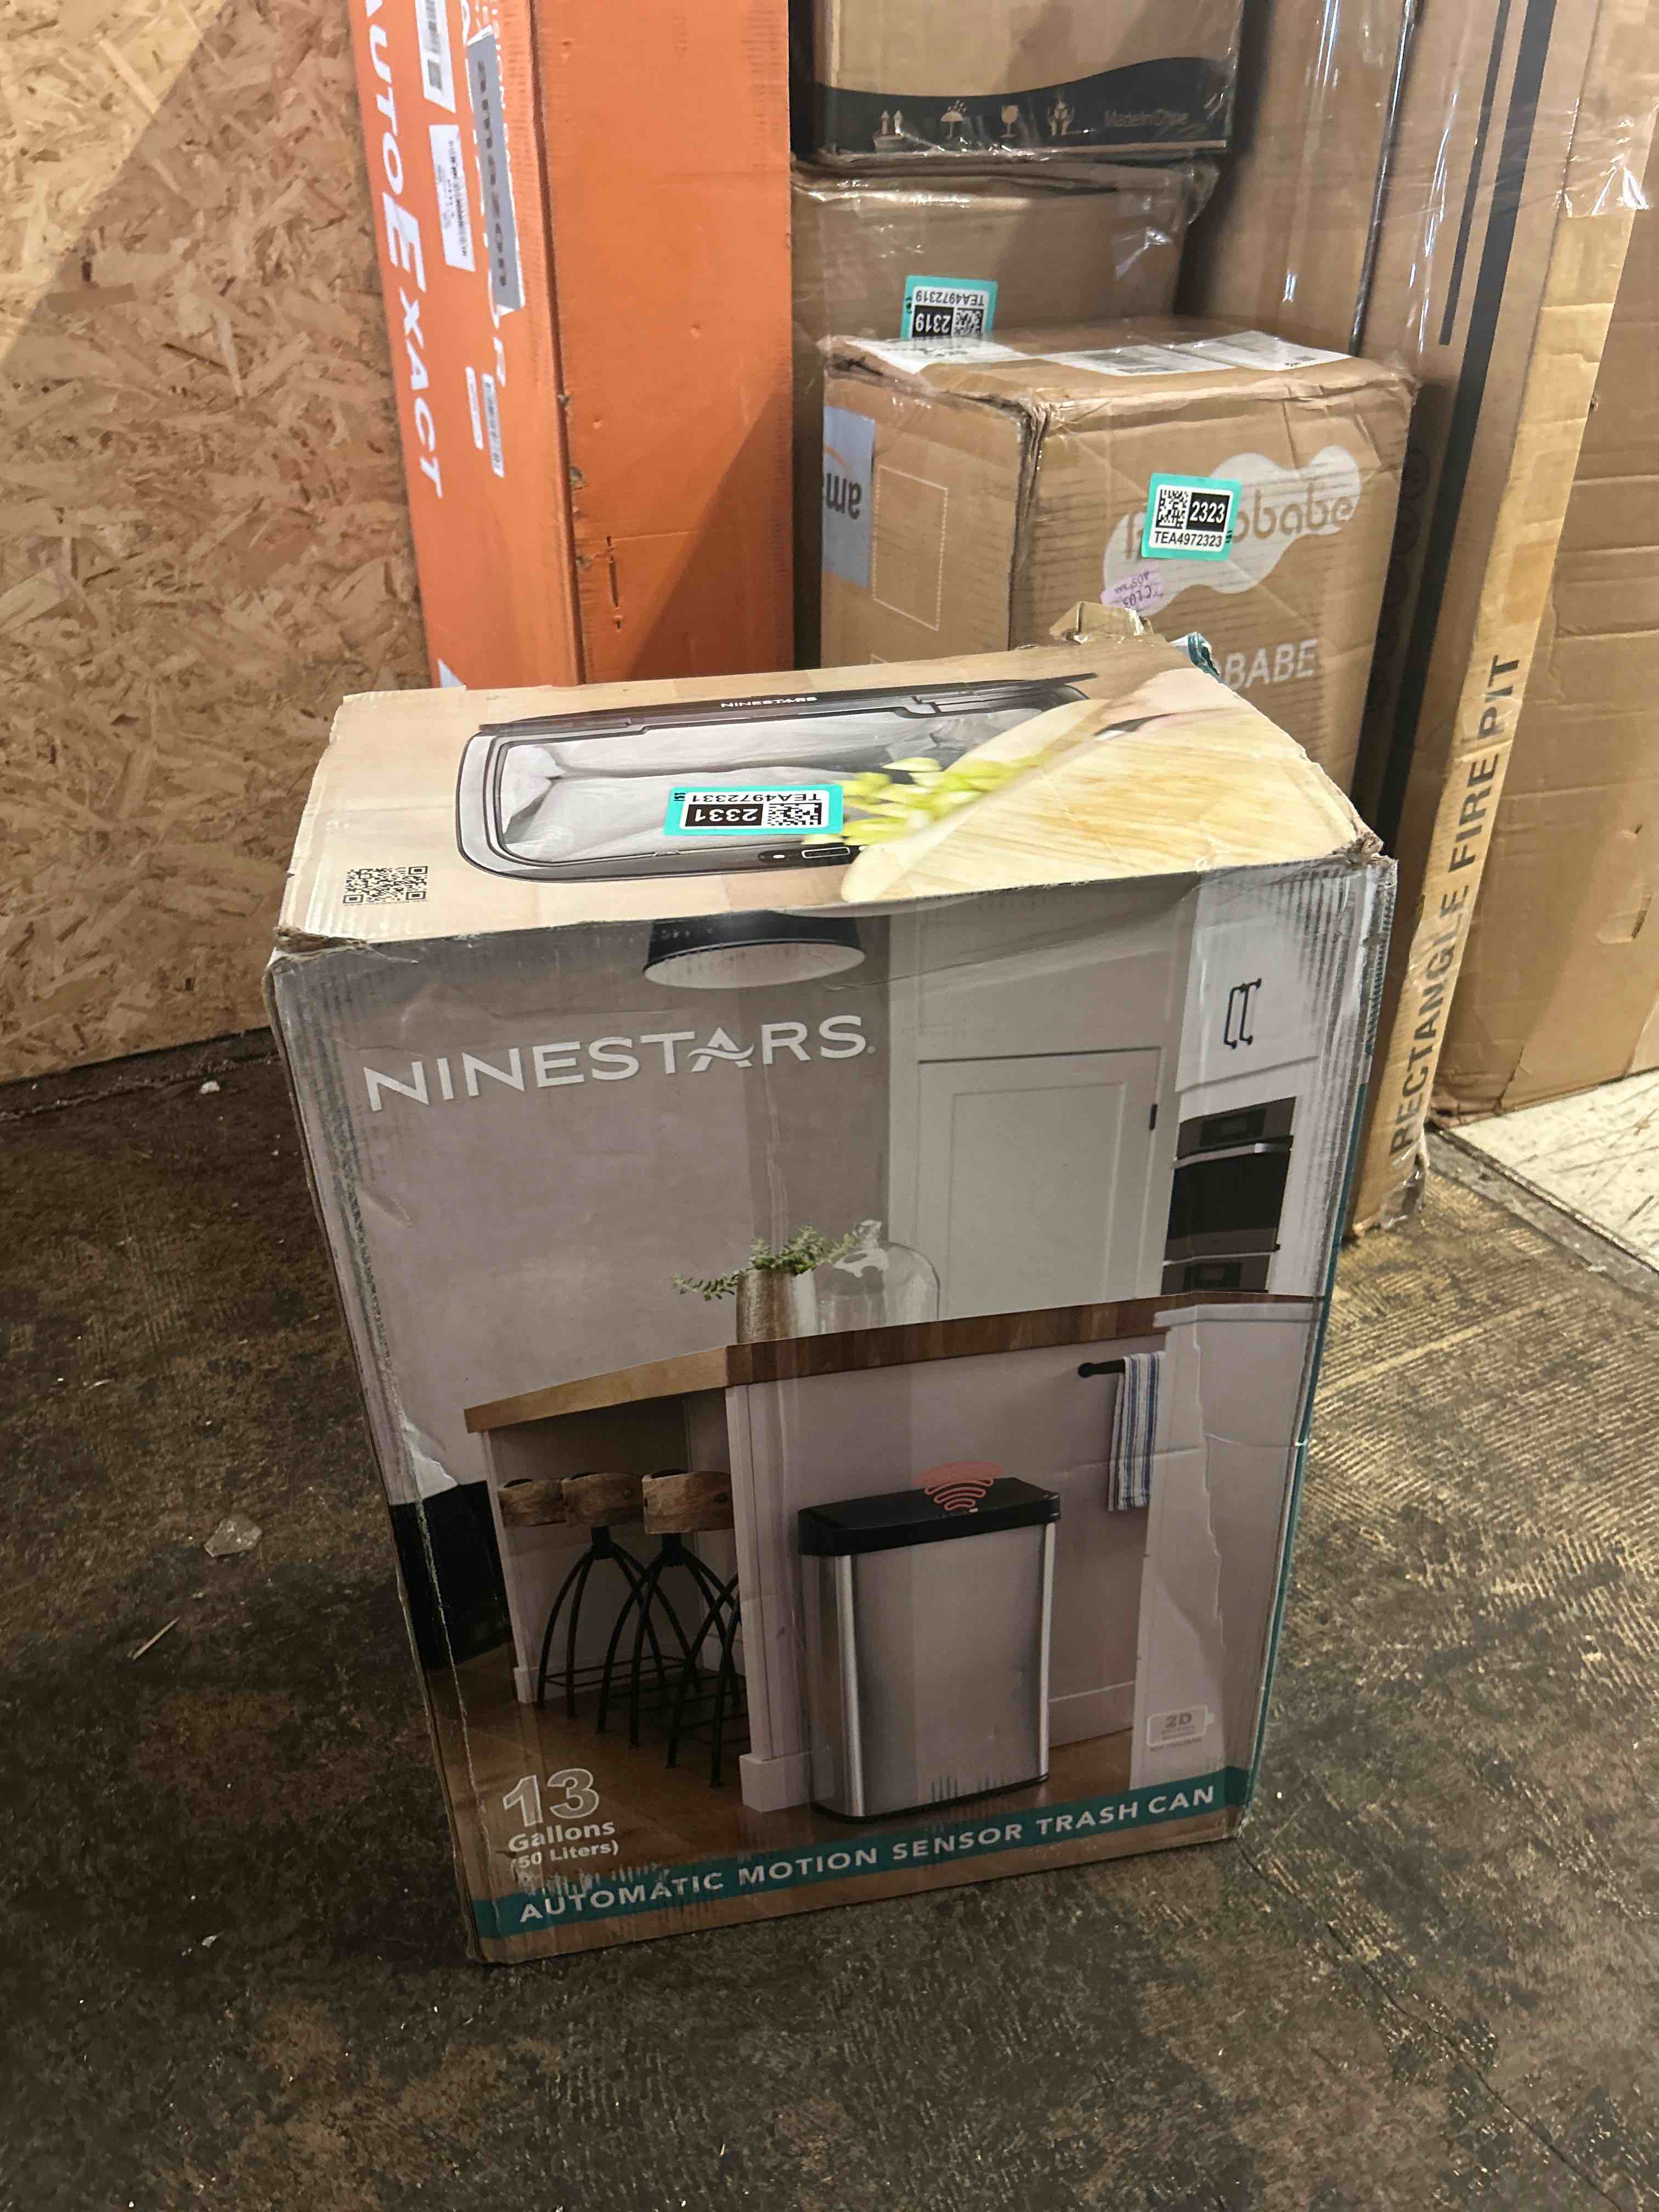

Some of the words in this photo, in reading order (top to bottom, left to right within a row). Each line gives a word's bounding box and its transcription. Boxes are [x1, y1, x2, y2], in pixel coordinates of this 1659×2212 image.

[916, 290, 985, 306] TEA4972319
[915, 313, 951, 334] 2319
[1189, 501, 1226, 524] 2323
[1154, 531, 1222, 547] TEA4972323
[1216, 638, 1318, 690] BABE
[721, 697, 817, 708] NINESTARS
[692, 793, 822, 803] TEA4972331
[694, 808, 759, 822] 2331
[1389, 885, 1469, 1156] RECTANGLE
[1448, 754, 1498, 873] FIRE
[1478, 654, 1519, 740] PIT
[364, 1015, 868, 1112] NINESTARS
[503, 1768, 600, 1827] 13
[508, 1821, 616, 1852] Gallons
[520, 1871, 724, 1922] AUTOMATIC
[738, 1848, 877, 1886] MOTION
[892, 1824, 1023, 1860] SENSOR
[1036, 1802, 1137, 1836] TRASH
[1148, 1785, 1215, 1814] CAN
[550, 1839, 619, 1861] Liters)
